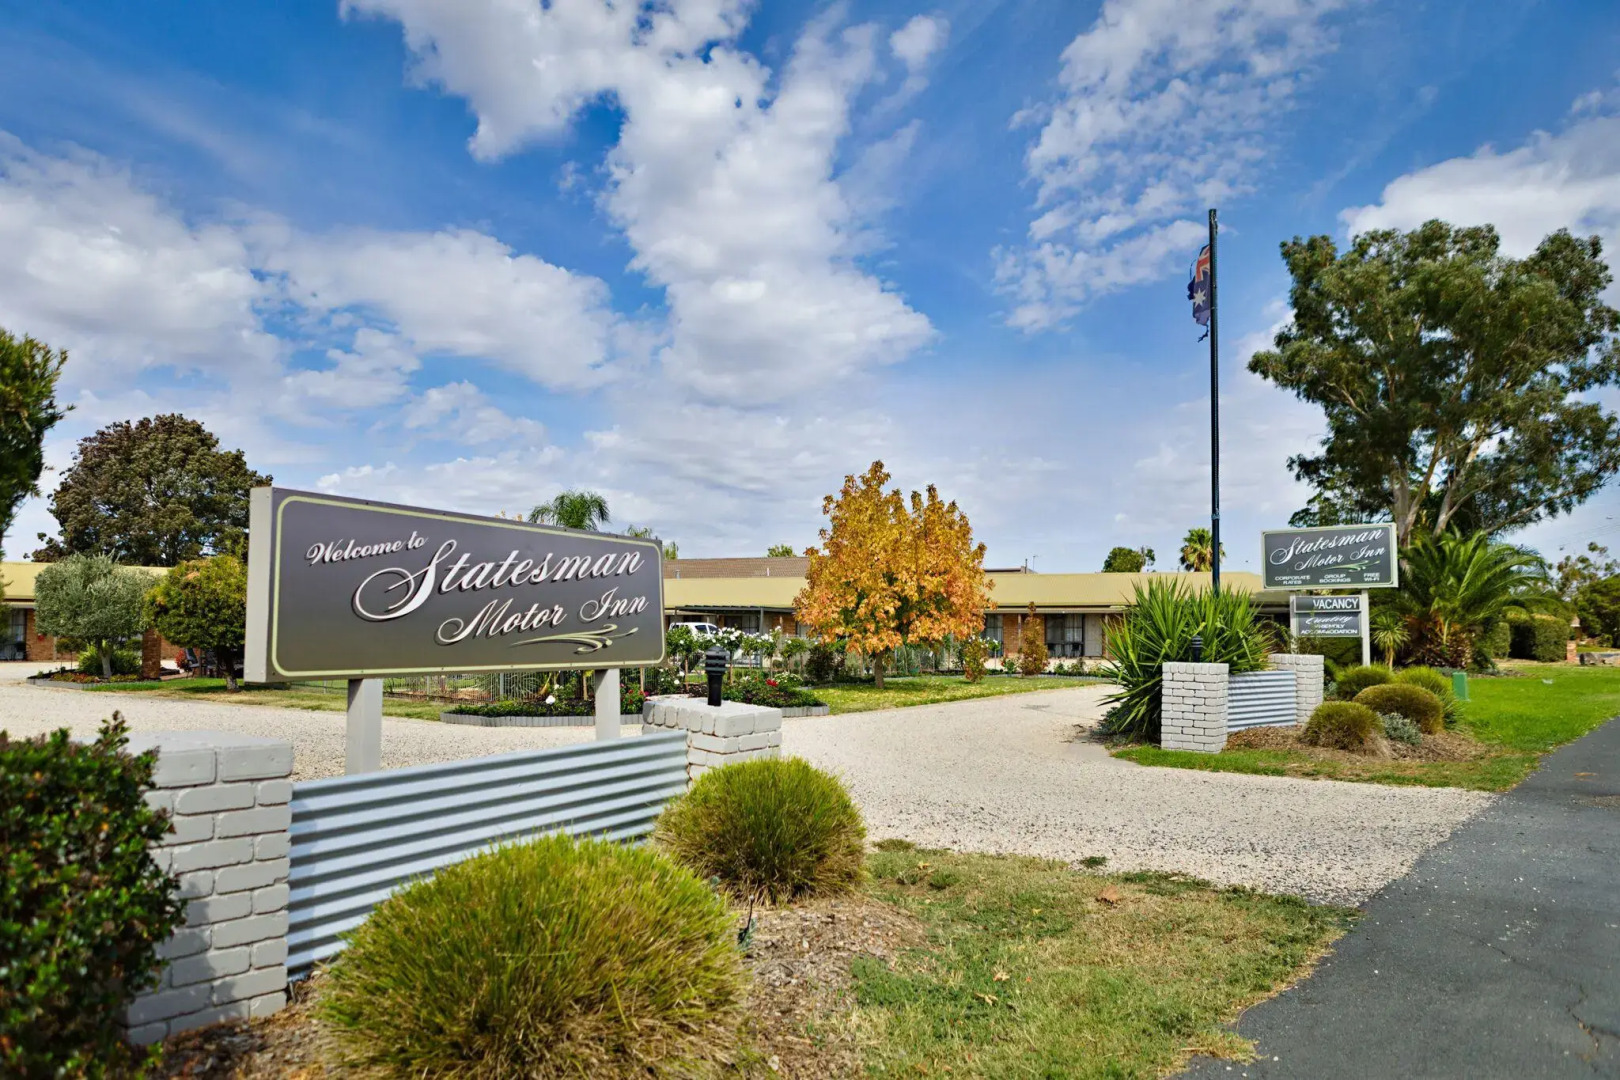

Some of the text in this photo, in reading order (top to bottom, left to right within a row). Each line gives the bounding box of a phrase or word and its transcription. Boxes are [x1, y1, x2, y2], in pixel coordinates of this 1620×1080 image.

[306, 531, 428, 565] Welcome to
[1270, 528, 1384, 565] Statesman
[1295, 545, 1385, 571] Motor Inn
[353, 539, 644, 621] Statesman
[437, 587, 649, 645] Motor Inn
[1313, 598, 1359, 610] VACANCY
